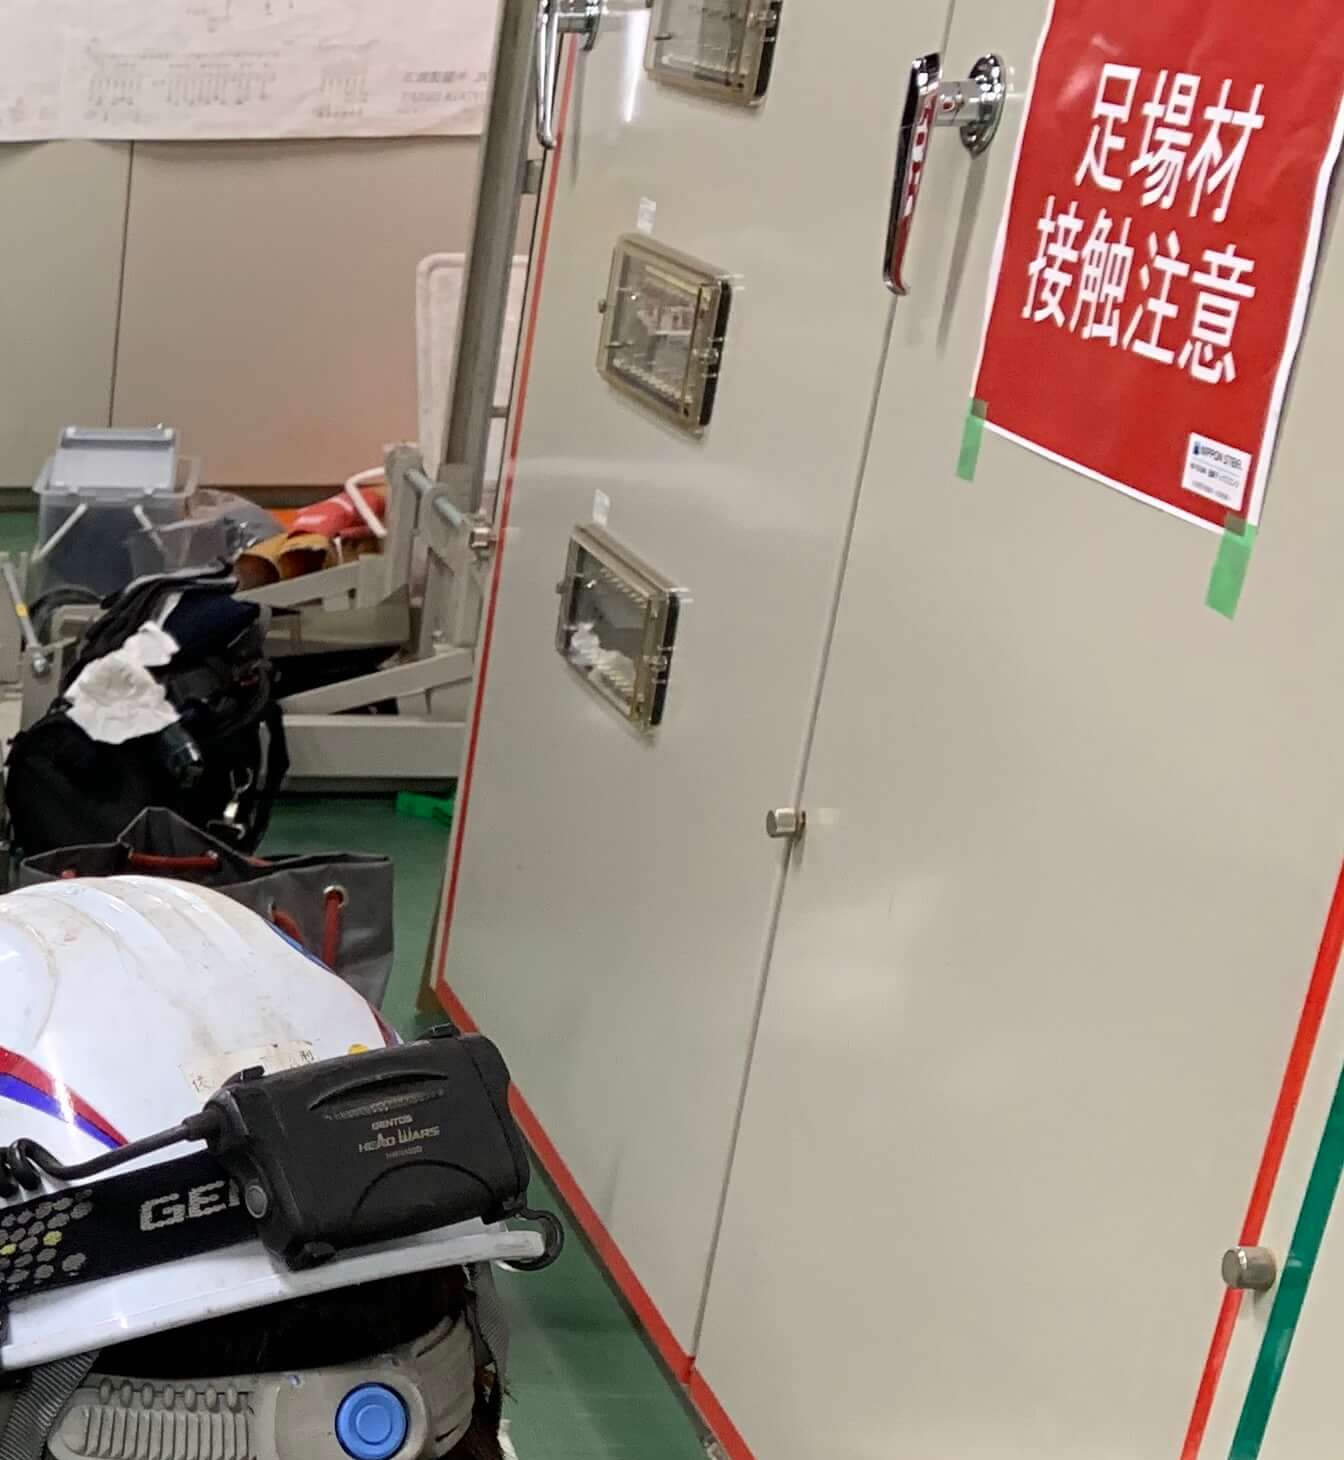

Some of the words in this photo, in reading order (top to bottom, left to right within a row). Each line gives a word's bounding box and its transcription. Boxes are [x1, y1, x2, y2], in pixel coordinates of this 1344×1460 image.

[1075, 62, 1265, 223] 足場材
[1022, 195, 1257, 385] 接触注意
